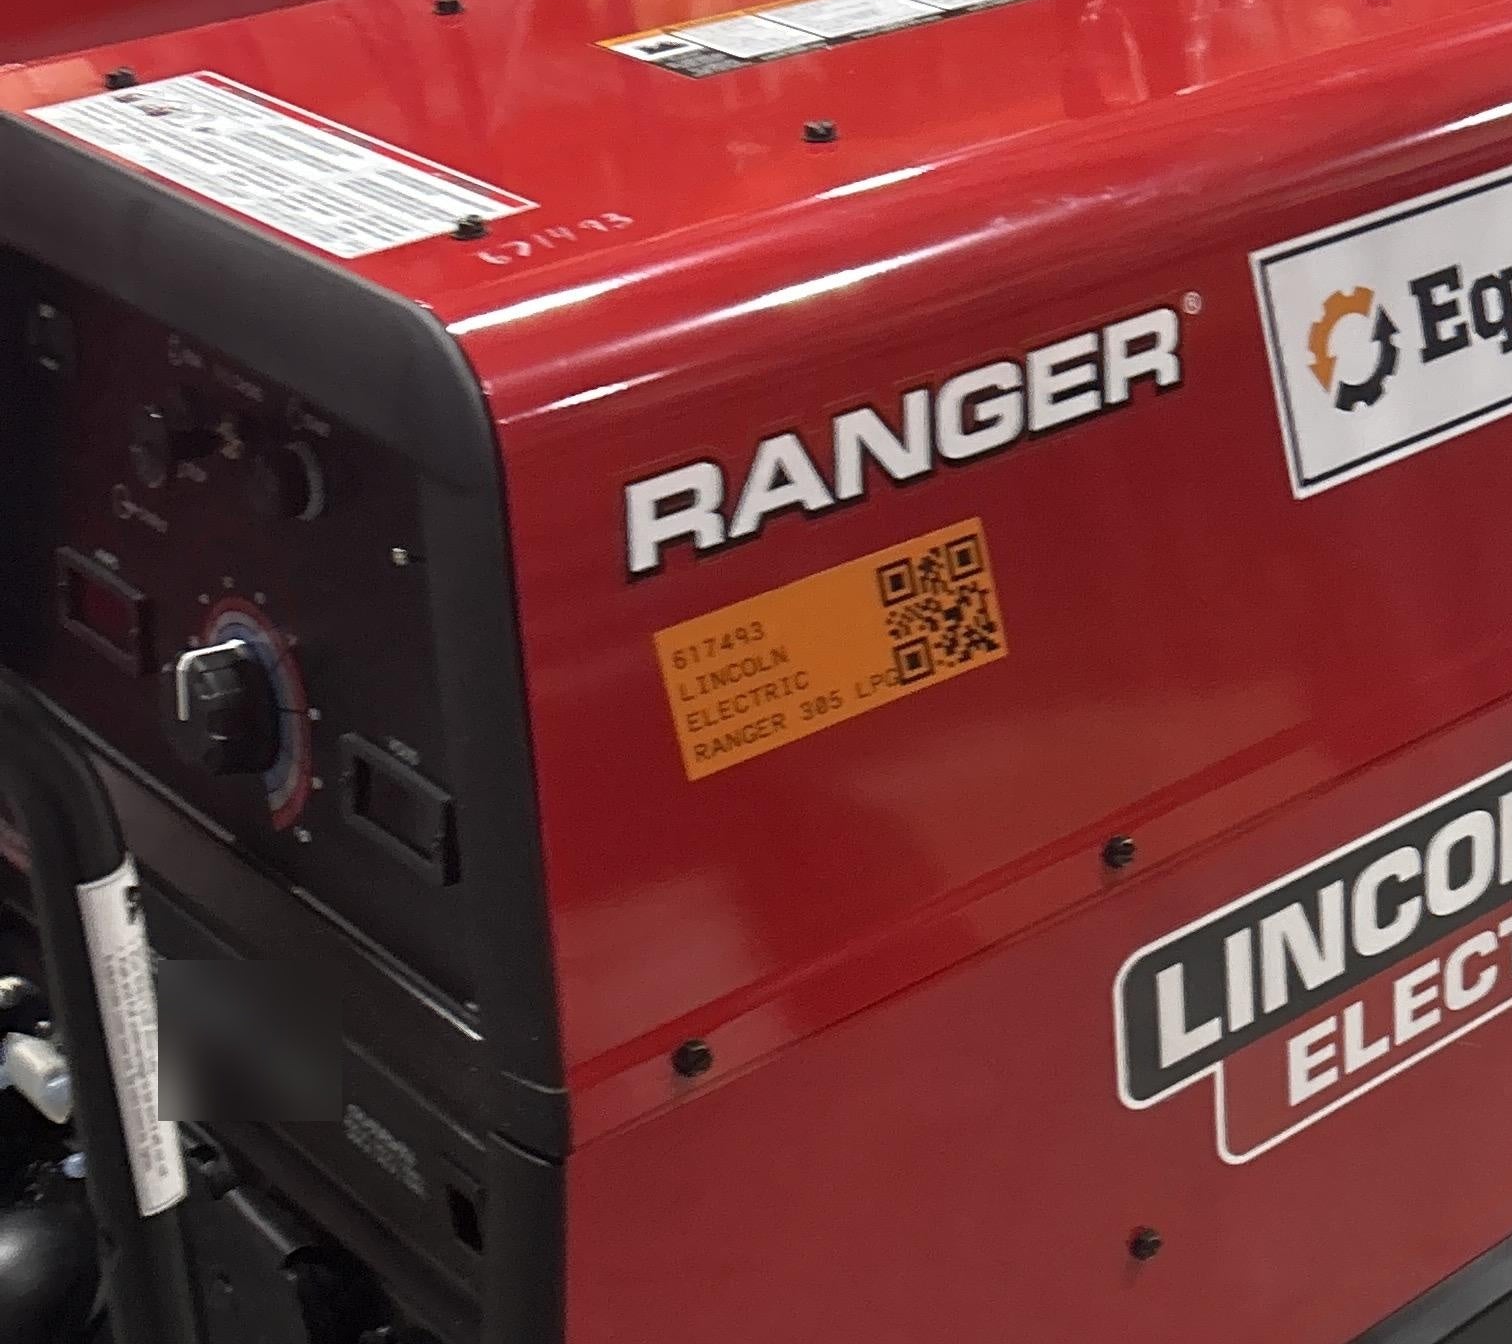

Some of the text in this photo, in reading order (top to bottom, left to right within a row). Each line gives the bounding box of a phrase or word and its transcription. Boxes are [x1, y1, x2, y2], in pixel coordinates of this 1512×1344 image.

[625, 307, 1181, 574] RANGER
[672, 621, 765, 670] 617493
[679, 646, 790, 702] LINCOLN
[686, 670, 810, 733] ELECTRIC
[694, 712, 787, 762] RANGER
[800, 689, 843, 721] 305
